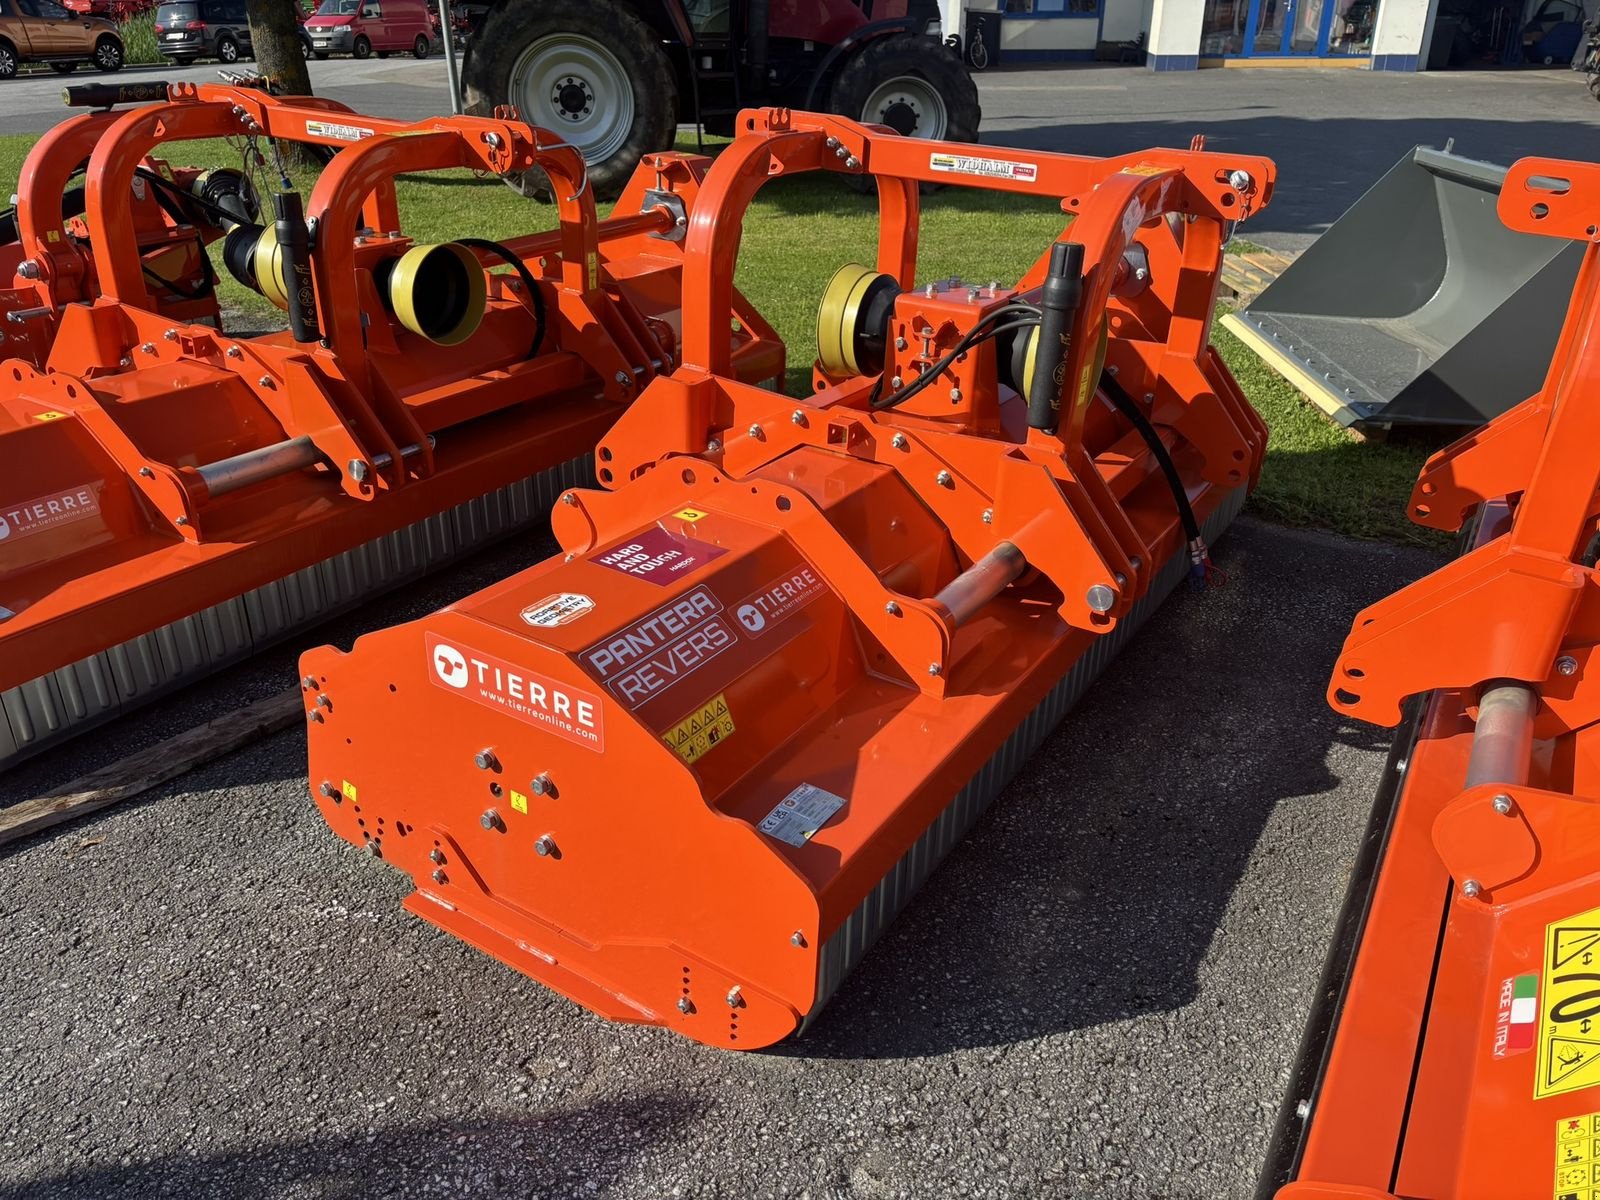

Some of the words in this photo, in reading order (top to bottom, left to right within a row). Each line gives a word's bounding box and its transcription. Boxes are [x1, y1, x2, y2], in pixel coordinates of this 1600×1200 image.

[7, 491, 91, 525] TIERRE
[600, 544, 644, 565] HARD
[617, 552, 650, 571] AND
[629, 550, 683, 575] TOUGH
[754, 568, 817, 612] TIERRE
[769, 582, 824, 619] www.tierreonline.com
[588, 591, 716, 676] PANTERA
[617, 622, 730, 703] REVERS
[470, 658, 594, 728] TIERRE
[479, 688, 599, 743] www.tierreonline.com
[1499, 976, 1514, 1009] MADE
[1493, 1024, 1510, 1058] ITALY
